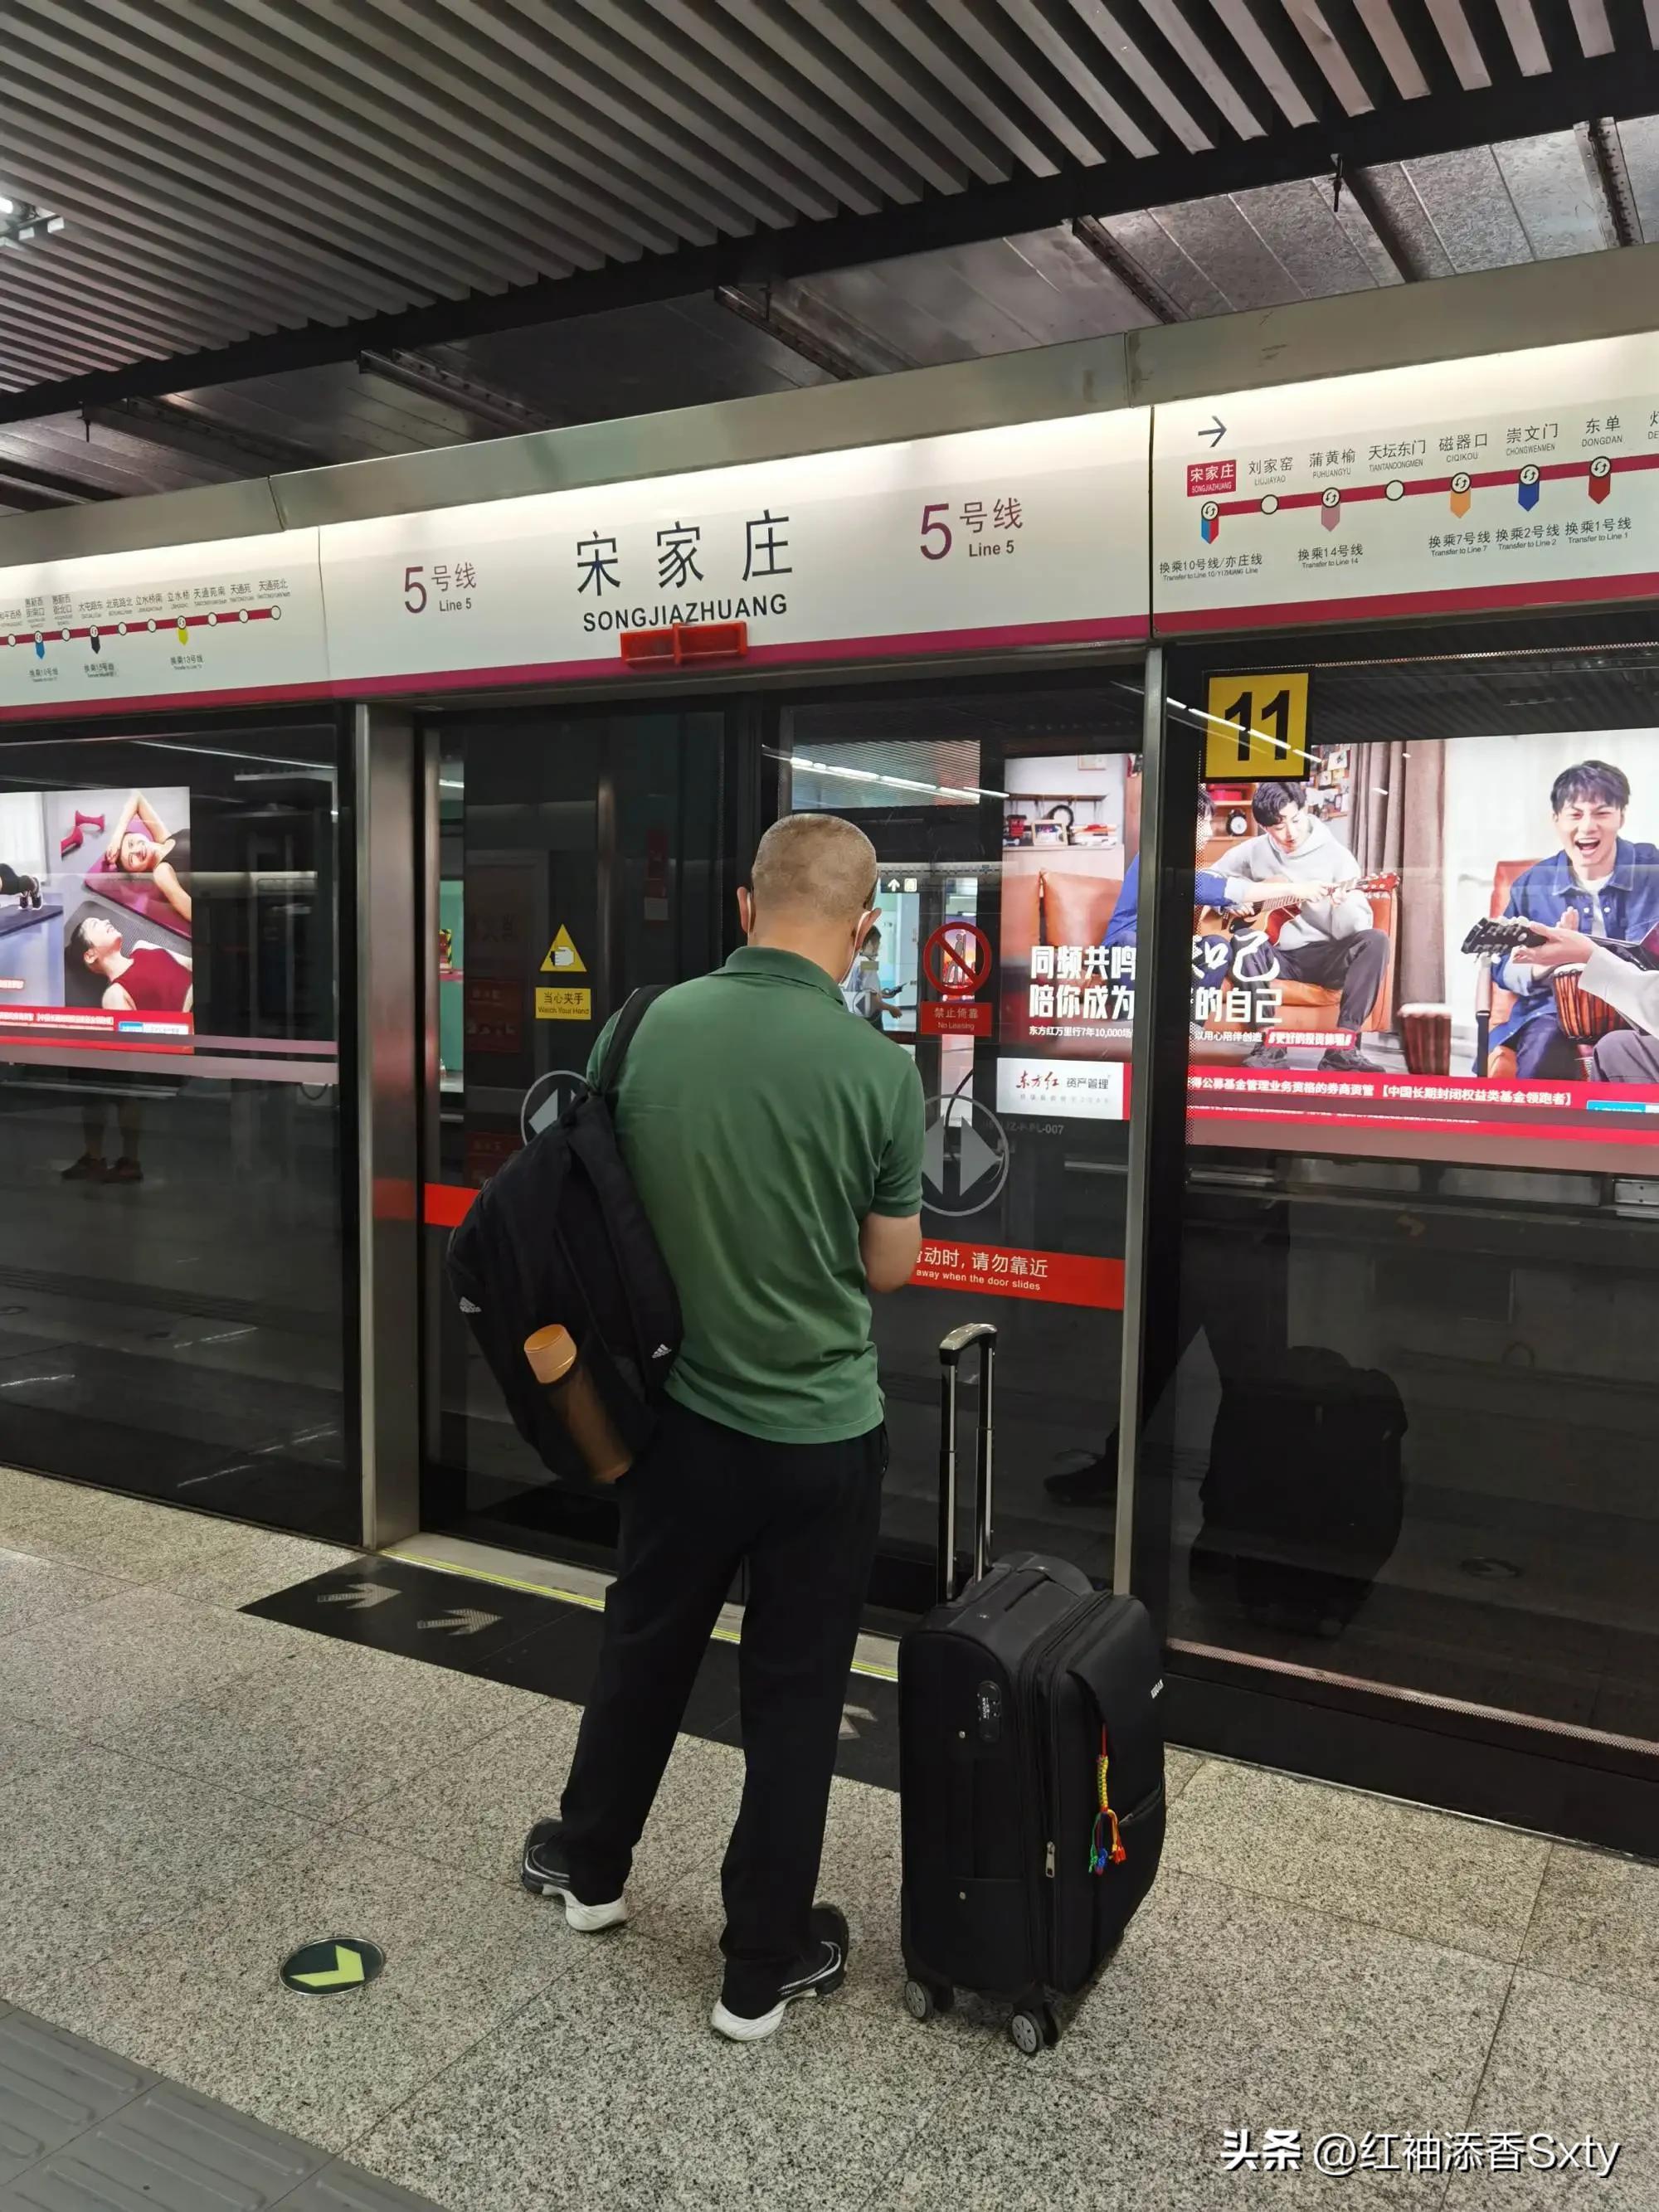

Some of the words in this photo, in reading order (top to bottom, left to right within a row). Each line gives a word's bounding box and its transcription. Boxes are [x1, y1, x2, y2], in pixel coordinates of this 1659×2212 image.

[1506, 423, 1559, 444] 崇文门
[1585, 415, 1621, 434] 东单
[1369, 440, 1426, 460] 天坛东门
[1439, 433, 1488, 453] 磁器口
[1506, 444, 1555, 456] CHONGWENMEN
[1582, 435, 1623, 447] DONGDAN
[1248, 457, 1293, 475] 刘家窑
[1309, 450, 1355, 468] 蒲黄榆
[1369, 459, 1423, 471] TIANTANDONGMEN
[1447, 452, 1478, 463] CIQIKOU
[1190, 464, 1234, 483] 宋家庄
[1254, 475, 1286, 486] LIUJIAYAO
[1313, 468, 1351, 479] PUHUANGYU
[1191, 481, 1232, 493] SONGJIAZHUANG
[1496, 524, 1559, 542] 换乘2号线
[1565, 517, 1632, 536] 换乘1号线
[1428, 530, 1491, 548] 换乘7号线
[1499, 542, 1526, 551] Transfer
[1569, 535, 1597, 544] Transfer
[1607, 533, 1622, 542] Line
[577, 509, 793, 596] 宋家庄
[968, 542, 1001, 557] Line
[1005, 539, 1015, 555] 5
[1298, 543, 1363, 562] 换乘14号线
[1431, 548, 1457, 557] Transfer
[1467, 546, 1481, 554] Line
[1160, 553, 1262, 574] 换乘10号线/亦庄线
[259, 578, 289, 591] 天通苑北
[439, 599, 461, 612] Line
[465, 597, 473, 610] 5
[582, 594, 788, 633] SONGJIAZHUANG
[1224, 690, 1290, 761] 11
[1031, 946, 1136, 980] 同频共鸣
[544, 991, 583, 1004] 当心夹手
[1029, 984, 1135, 1019] 陪你成为
[1195, 987, 1282, 1023] 的自己
[934, 1007, 979, 1019] 禁止倚靠
[916, 1247, 1048, 1278] 动时，请勿靠近
[916, 1269, 940, 1281] away
[942, 1272, 966, 1282] when
[970, 1275, 985, 1284] the
[987, 1277, 1009, 1286] door
[1012, 1280, 1040, 1291] slides
